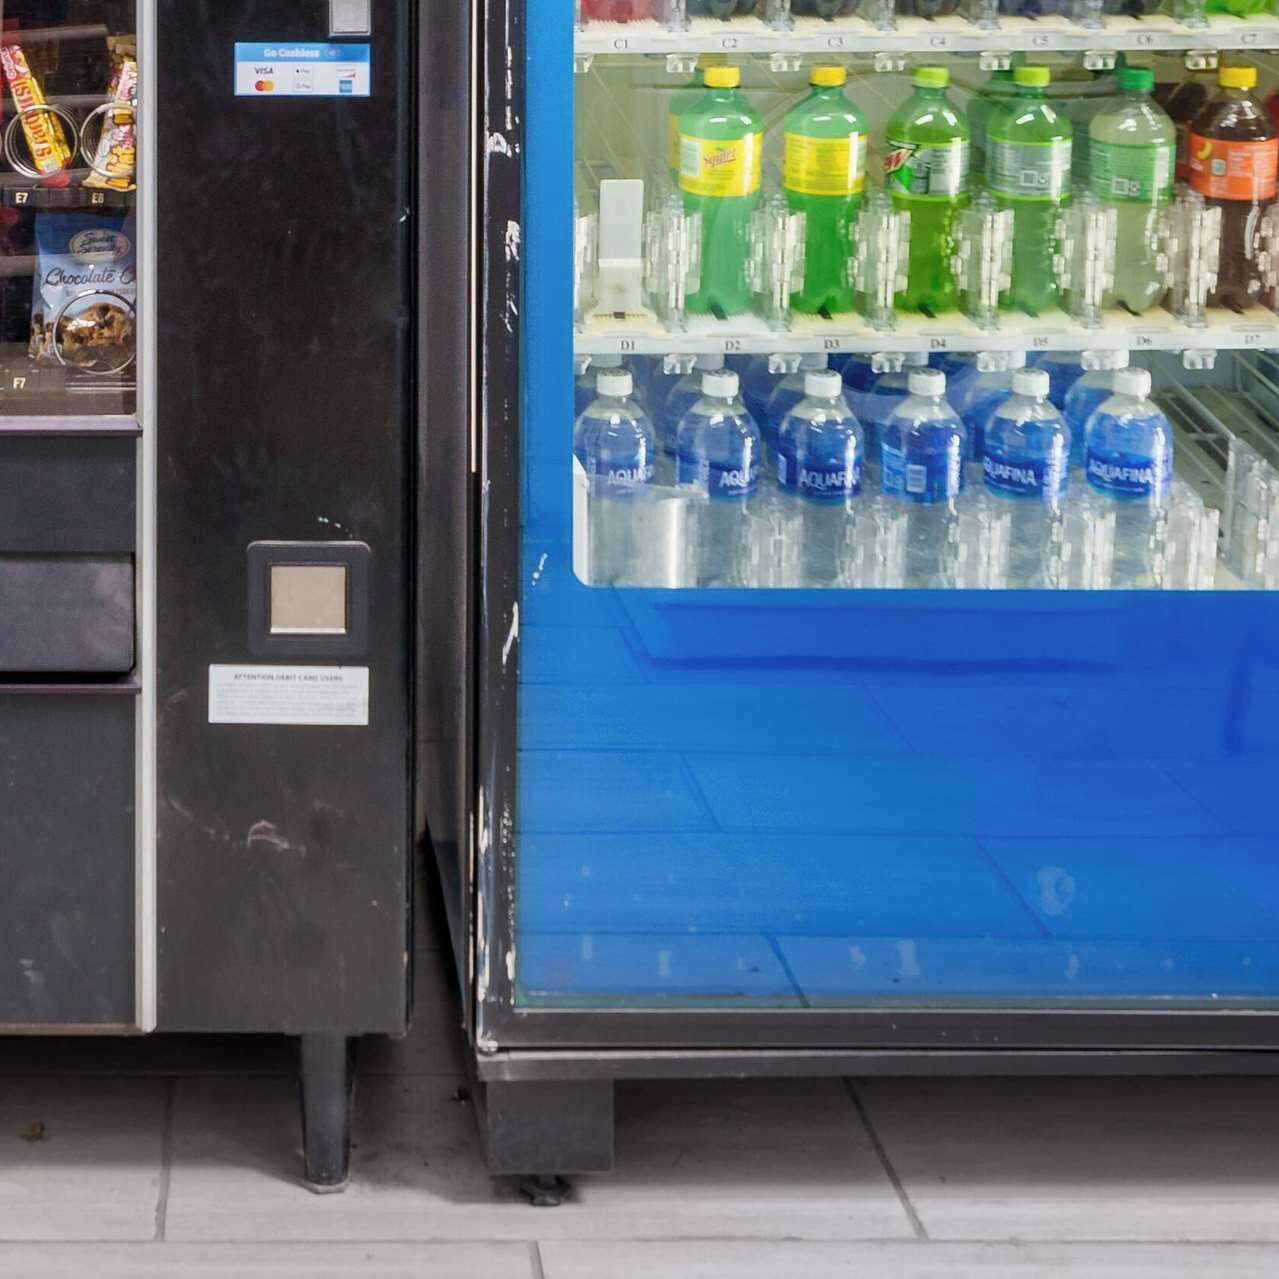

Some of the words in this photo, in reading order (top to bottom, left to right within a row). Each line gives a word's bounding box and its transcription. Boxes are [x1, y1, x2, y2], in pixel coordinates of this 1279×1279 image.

[613, 38, 629, 49] C1
[721, 37, 738, 49] C2
[15, 191, 29, 203] E7
[46, 267, 116, 286] Chocolate
[619, 339, 636, 350] D1
[725, 339, 741, 350] D2
[13, 377, 27, 389] F7
